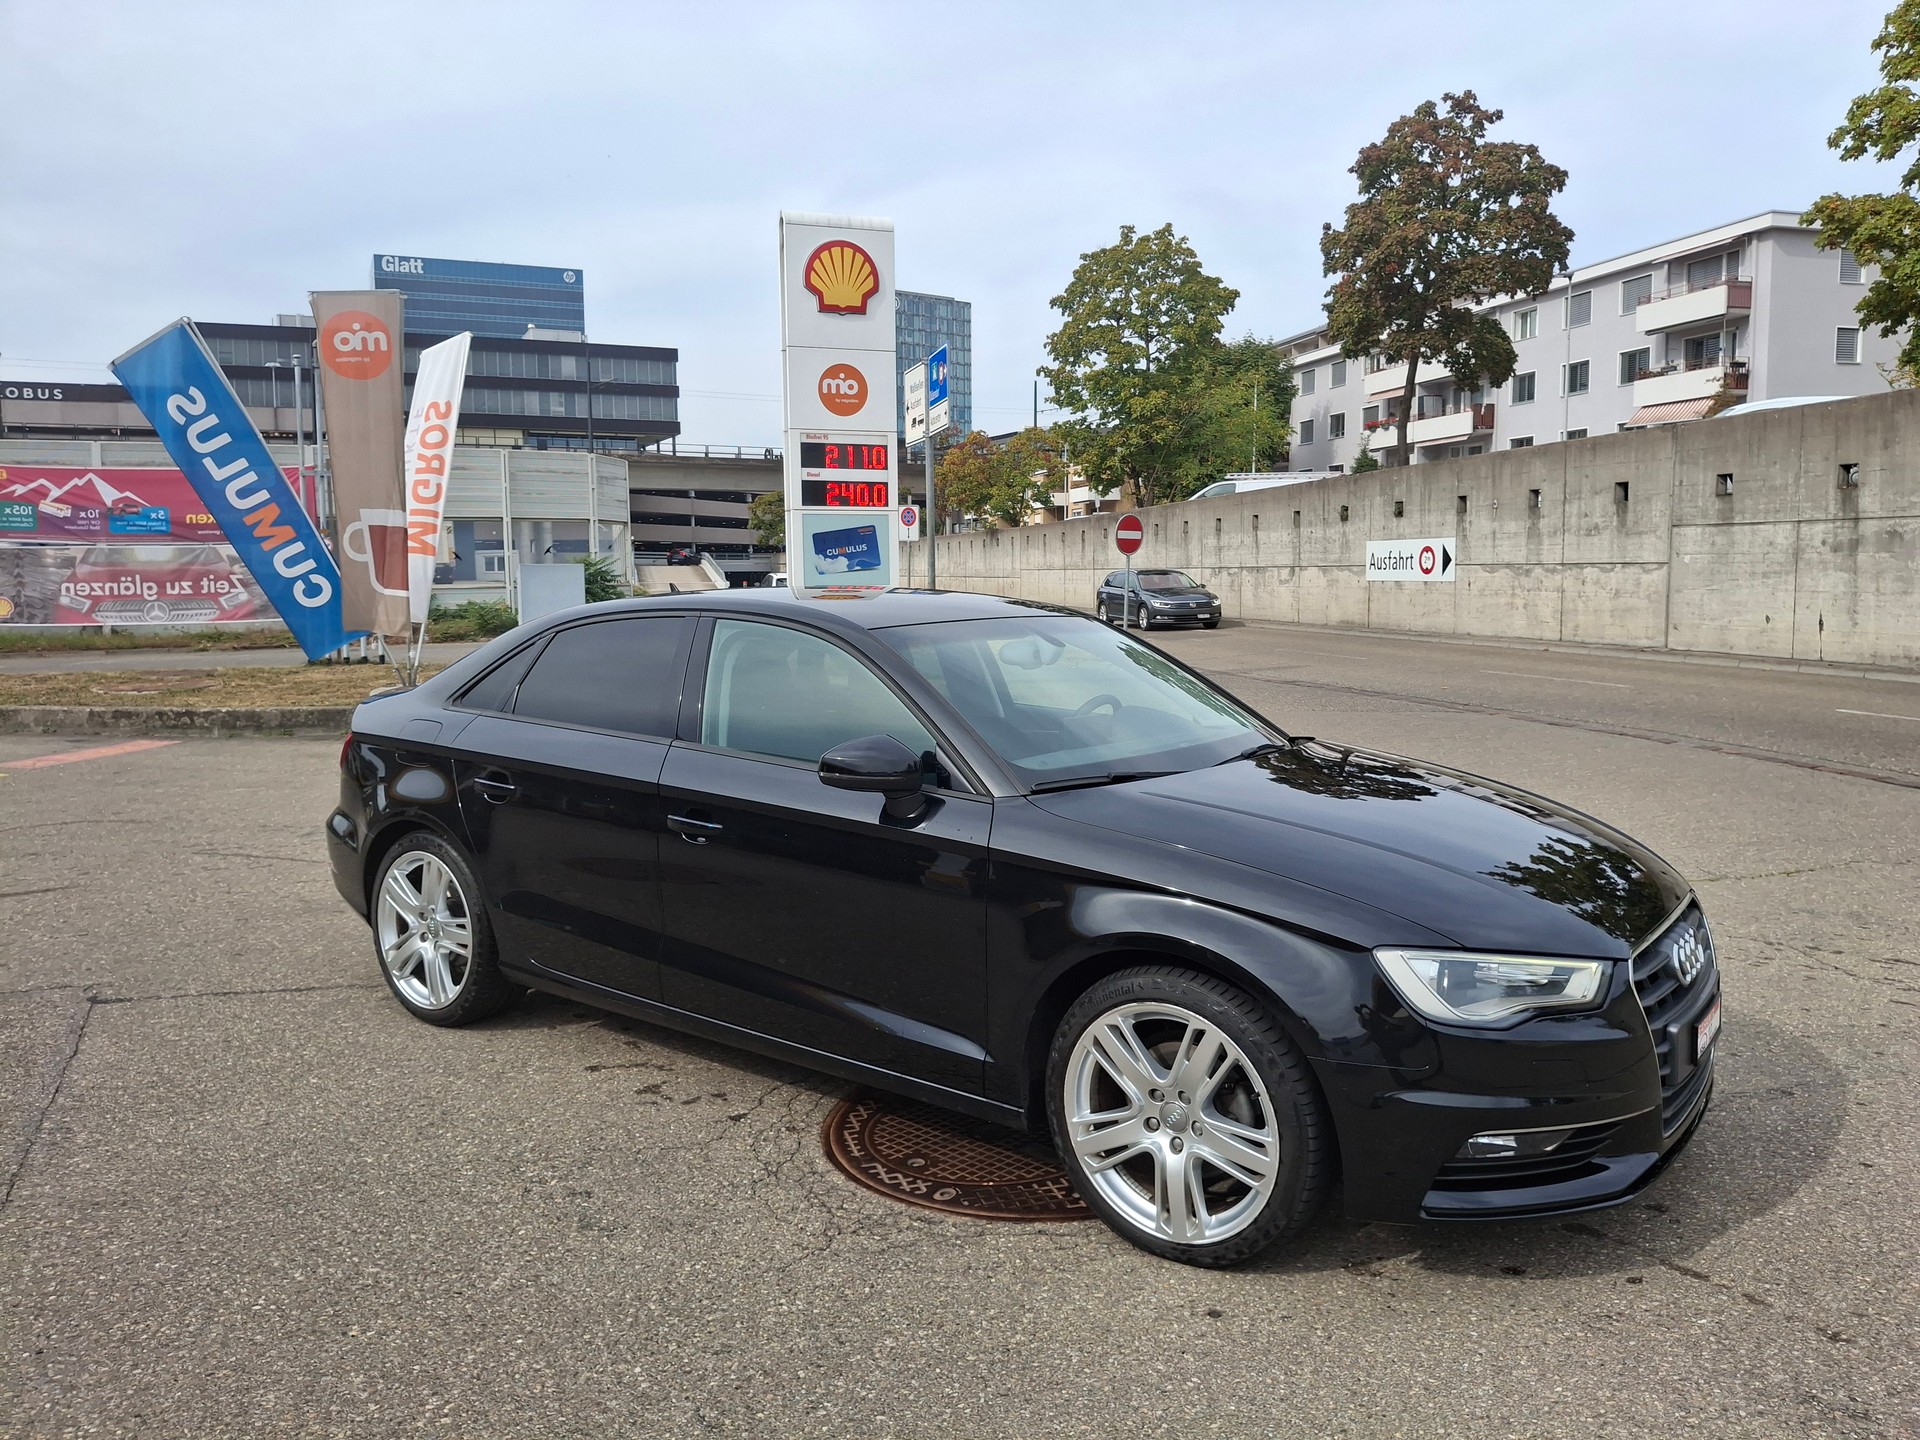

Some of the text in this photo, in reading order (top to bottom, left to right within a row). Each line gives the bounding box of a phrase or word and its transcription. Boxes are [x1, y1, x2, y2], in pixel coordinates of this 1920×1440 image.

[381, 256, 424, 274] Glatt
[0, 386, 63, 401] OBUS
[822, 372, 859, 395] mio
[825, 445, 886, 469] 211.0
[826, 483, 886, 506] 240.0
[826, 543, 868, 557] CUMULUS
[1369, 550, 1414, 571] Ausfahrt
